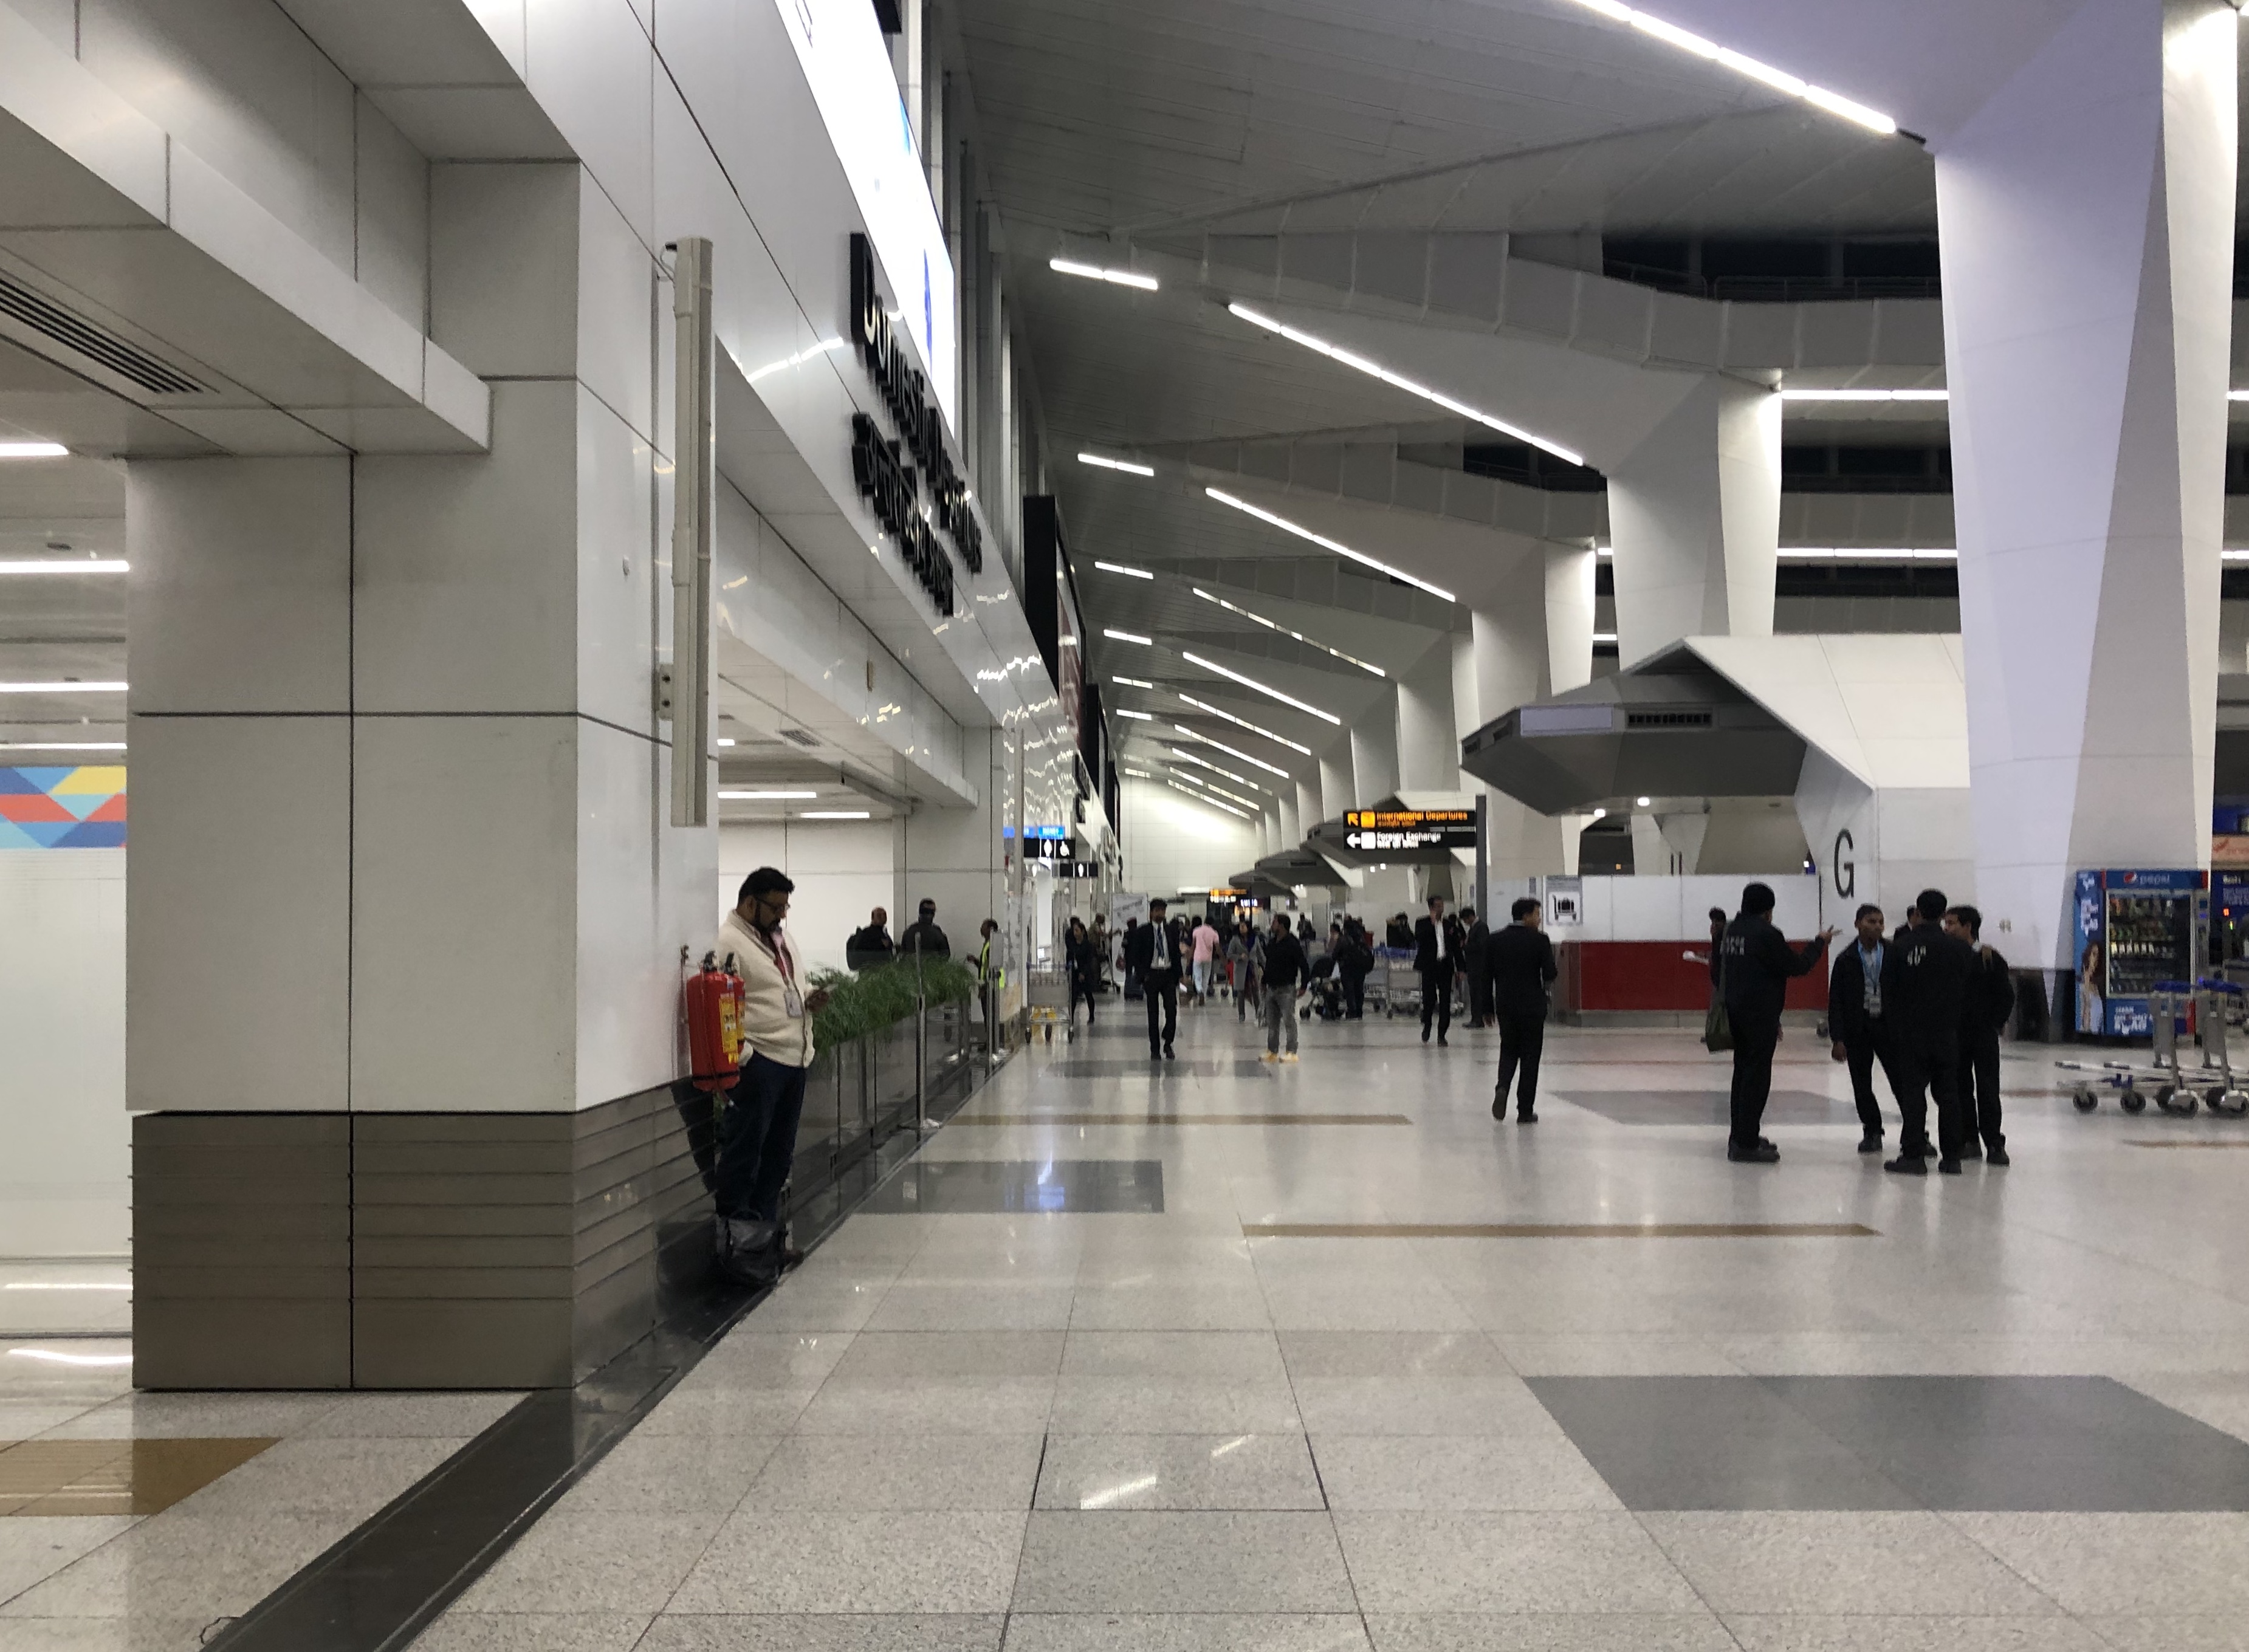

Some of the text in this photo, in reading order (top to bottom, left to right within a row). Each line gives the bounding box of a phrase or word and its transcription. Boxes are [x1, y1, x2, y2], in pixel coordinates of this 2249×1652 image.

[851, 231, 982, 574] Domestic Departures
[1377, 811, 1468, 821] International Departures
[1377, 831, 1441, 843] Foreign Exchange
[1834, 828, 1854, 899] G
